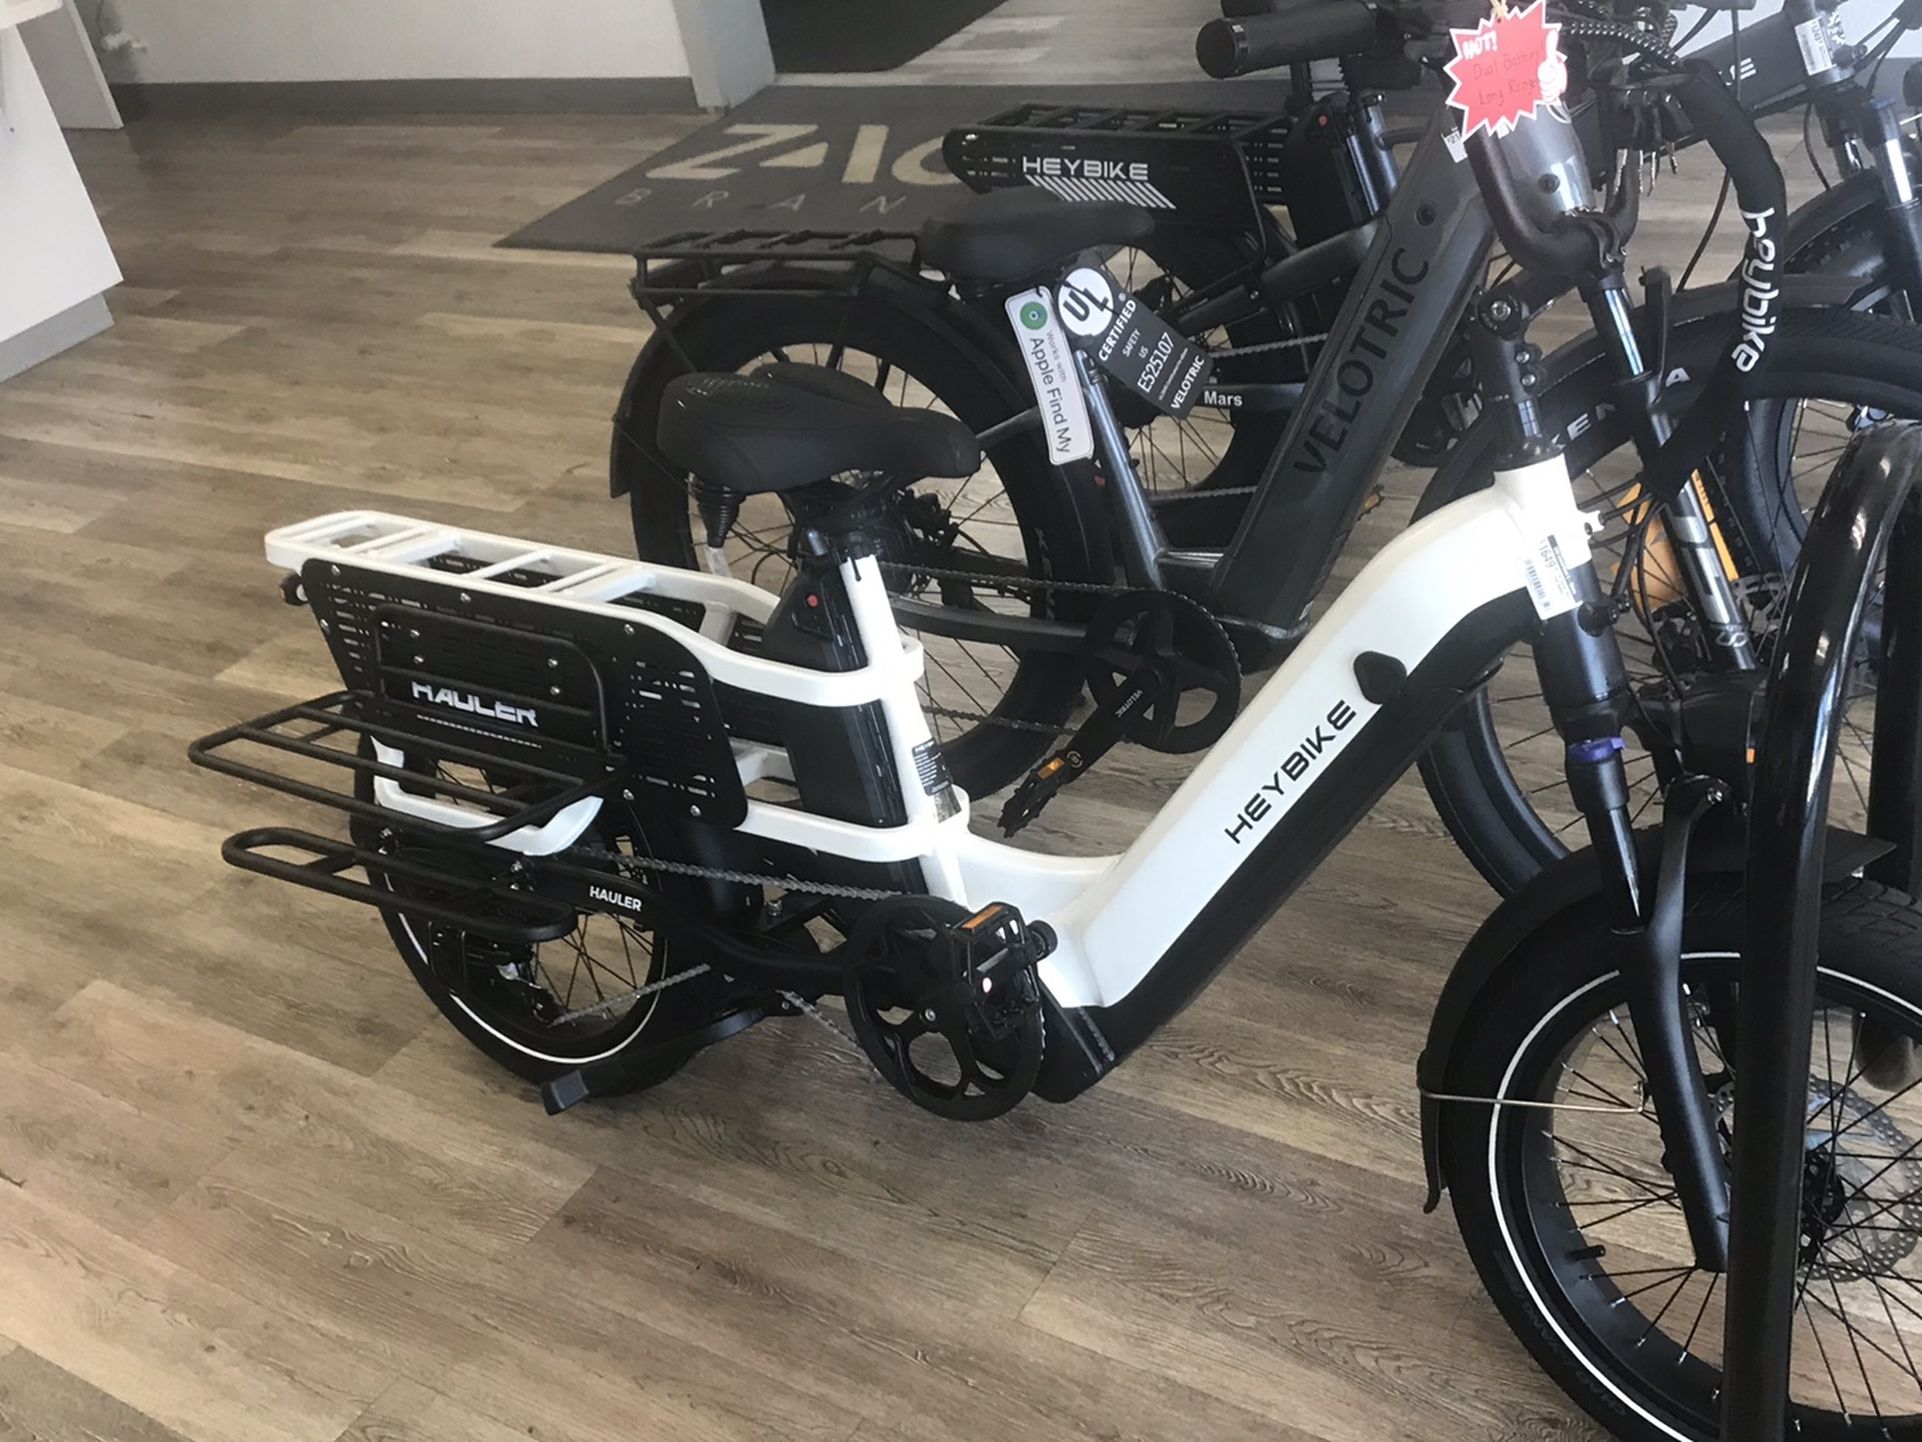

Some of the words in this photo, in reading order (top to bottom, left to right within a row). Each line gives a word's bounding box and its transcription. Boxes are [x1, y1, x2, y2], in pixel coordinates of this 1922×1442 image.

[1462, 31, 1498, 60] HOT!
[1022, 155, 1149, 181] HEYBIKE
[614, 187, 907, 215] BRAN
[1062, 287, 1111, 322] UL
[1731, 207, 1780, 372] heybike
[1098, 299, 1137, 362] CERTIFIED
[1121, 328, 1142, 358] SAFETY
[1029, 337, 1054, 386] Apple
[1136, 331, 1176, 394] E525107
[1293, 247, 1430, 474] VELOTRIC
[1170, 354, 1205, 410] VELOTRIC
[1203, 390, 1243, 407] Mars
[1047, 385, 1065, 426] Find
[1055, 427, 1072, 454] My
[411, 680, 539, 728] HAULER
[1224, 699, 1357, 844] HEYBIKE
[589, 885, 642, 912] HAULER
